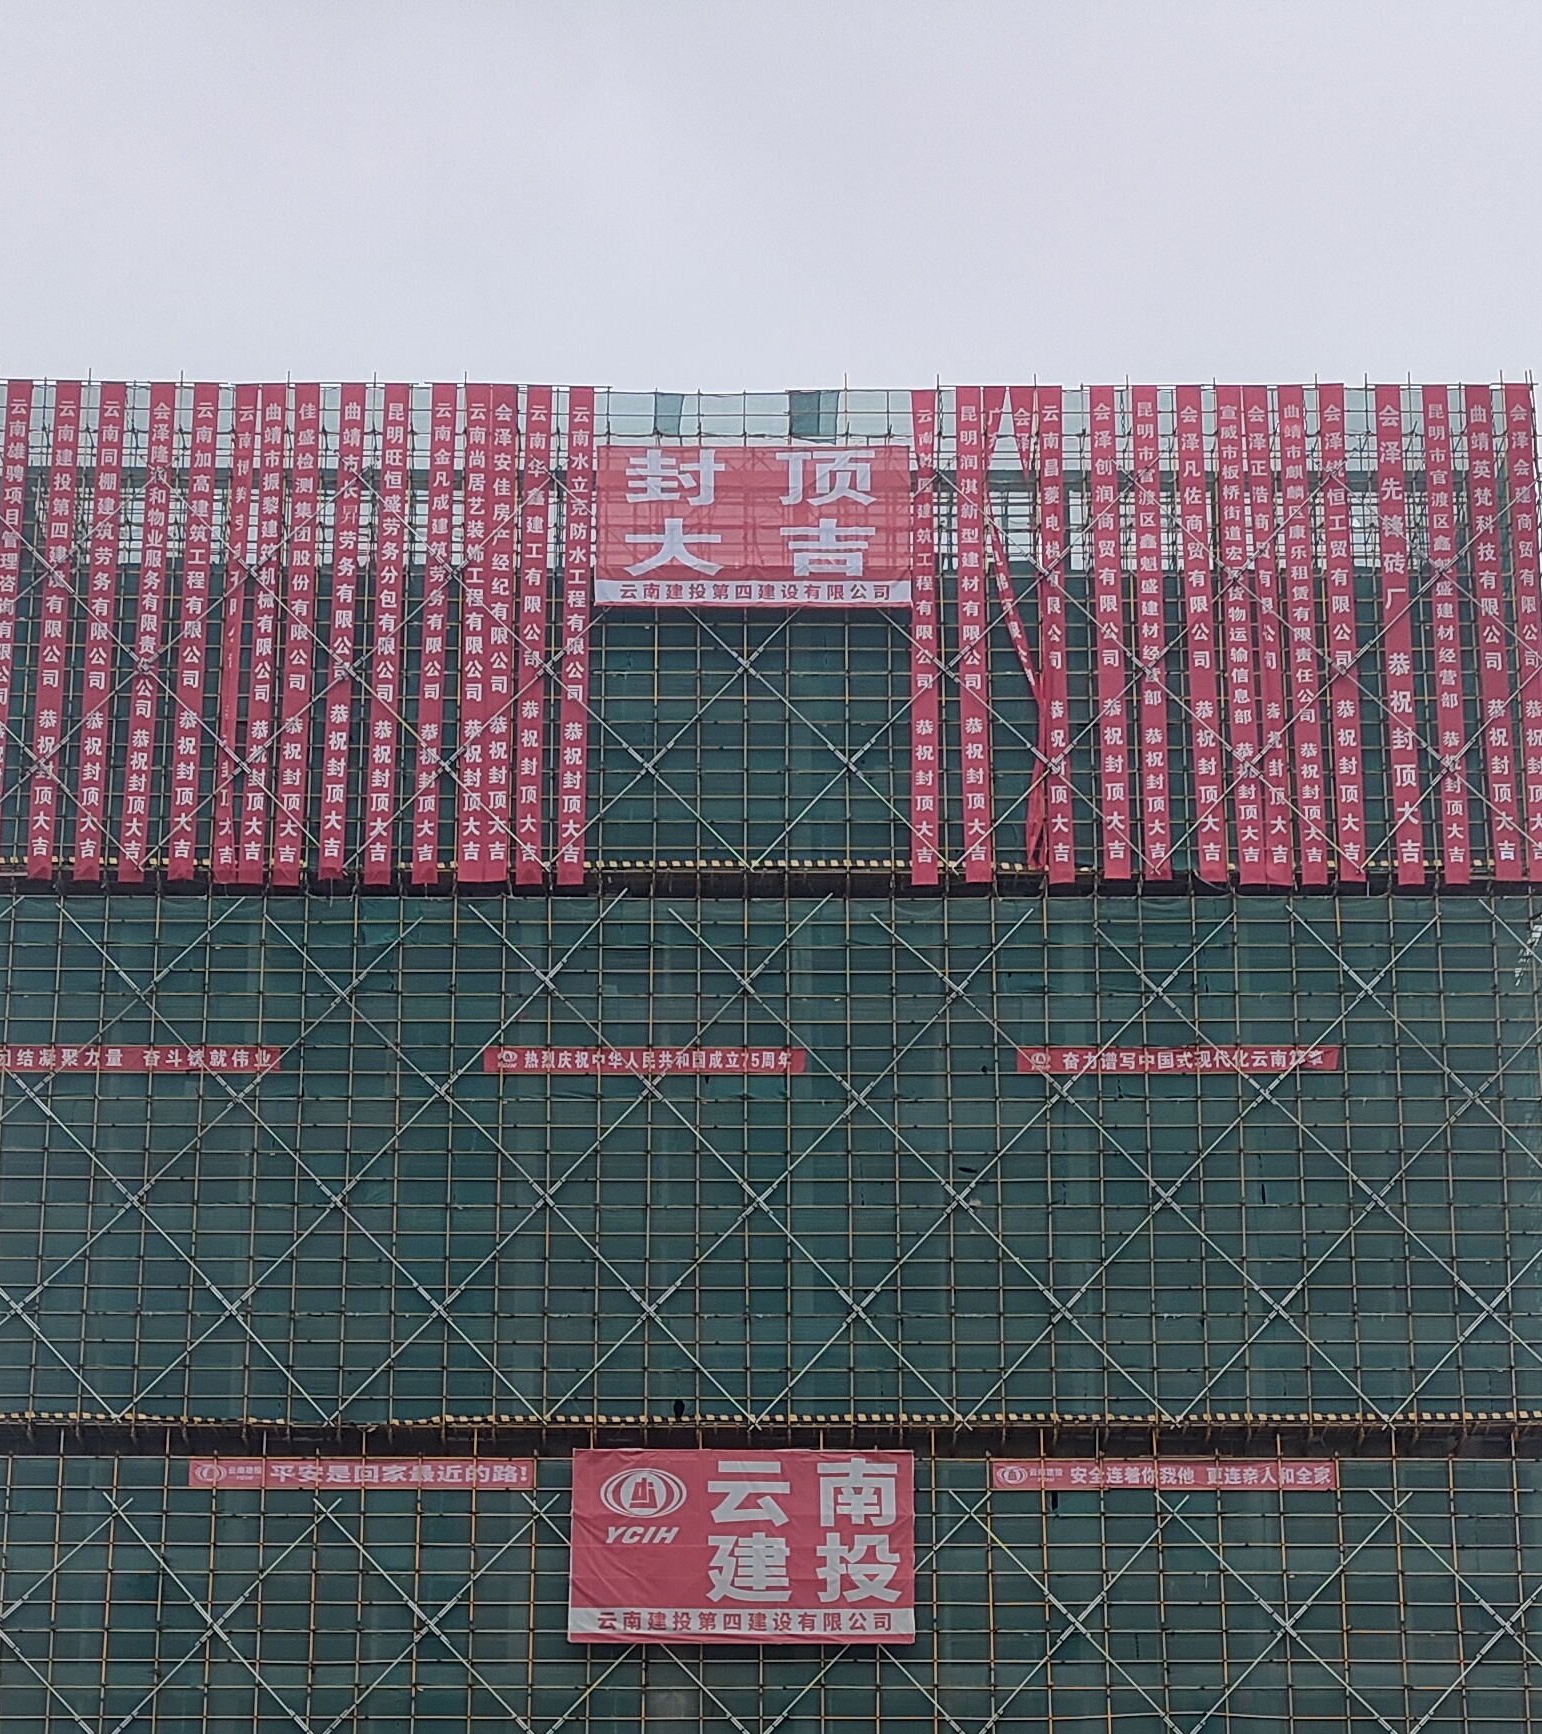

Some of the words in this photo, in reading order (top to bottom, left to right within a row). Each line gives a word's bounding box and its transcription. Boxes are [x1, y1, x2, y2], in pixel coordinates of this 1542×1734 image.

[42, 400, 76, 688] 云南建投第四建设有限公司
[182, 402, 214, 688] 云南加高建筑工程有限公司
[288, 402, 318, 691] 佳盛检测集团股份有限公司
[490, 403, 512, 694] 会泽安佳房产经纪有限公司
[624, 449, 877, 506] 封顶
[624, 518, 876, 577] 大吉
[959, 405, 982, 690] 昆明润淇新型建材有限公司
[1093, 403, 1119, 667] 会泽创润商贸有限公司
[1180, 405, 1211, 669] 会泽凡佐商贸有限公司
[1378, 404, 1407, 610] 会泽先锋砖厂
[376, 403, 405, 702] 昆明旺恒盛劳务分包有限公司
[464, 403, 488, 702] 云南尚居艺装饰工程有限公司
[619, 584, 891, 600] 云南建投第四建设有限公司
[1284, 405, 1316, 723] 曲靖市麒麟区康乐租赁有限责任公司
[1300, 742, 1323, 863] 恭祝封顶大吉
[1470, 404, 1503, 672] 曲靖英梵科技有限公司
[1487, 698, 1516, 861] 恭祝封顶大吉
[32, 709, 59, 857] 恭祝封顶大吉
[79, 711, 104, 859] 恭祝封顶大吉
[124, 729, 150, 860] 恭祝封顶大吉
[173, 711, 198, 859] 恭祝封顶大吉
[244, 720, 268, 861] 恭祝封顶大吉
[278, 717, 304, 863] 恭祝封顶大吉
[323, 704, 349, 858] 恭祝封顶大吉
[369, 720, 392, 862] 恭祝封顶大吉
[416, 723, 439, 862] 恭祝封顶大吉
[462, 720, 483, 861] 恭祝封顶大吉
[487, 715, 509, 861] 恭祝封顶大吉
[520, 700, 540, 862] 恭祝封顶大吉
[562, 722, 583, 863] 恭祝封顶大吉
[915, 719, 934, 863] 恭祝封顶大吉
[965, 717, 987, 861] 恭祝封顶大吉
[1050, 700, 1070, 862] 恭祝封顶大吉
[1103, 699, 1126, 859] 恭祝封顶大吉
[1145, 728, 1167, 859] 恭祝封顶大吉
[1195, 700, 1221, 861] 恭祝封顶大吉
[1236, 742, 1260, 863] 恭祝封顶大吉
[1266, 702, 1288, 864] 恭祝封顶大吉
[1337, 699, 1361, 861] 恭祝封顶大吉
[1388, 652, 1421, 864] 恭祝封顶大吉
[1442, 731, 1465, 863] 恭祝封顶大吉
[143, 1048, 271, 1068] 奋斗铸就伟业
[524, 1050, 792, 1069] 热烈庆祝中华人民共和国成立75周年
[606, 1527, 679, 1544] YCIH
[708, 1458, 898, 1527] 云南
[1070, 1466, 1195, 1484] 安全连着你我他
[597, 1611, 893, 1632] 云南建投第四建设有限公司
[706, 1532, 903, 1603] 建投
